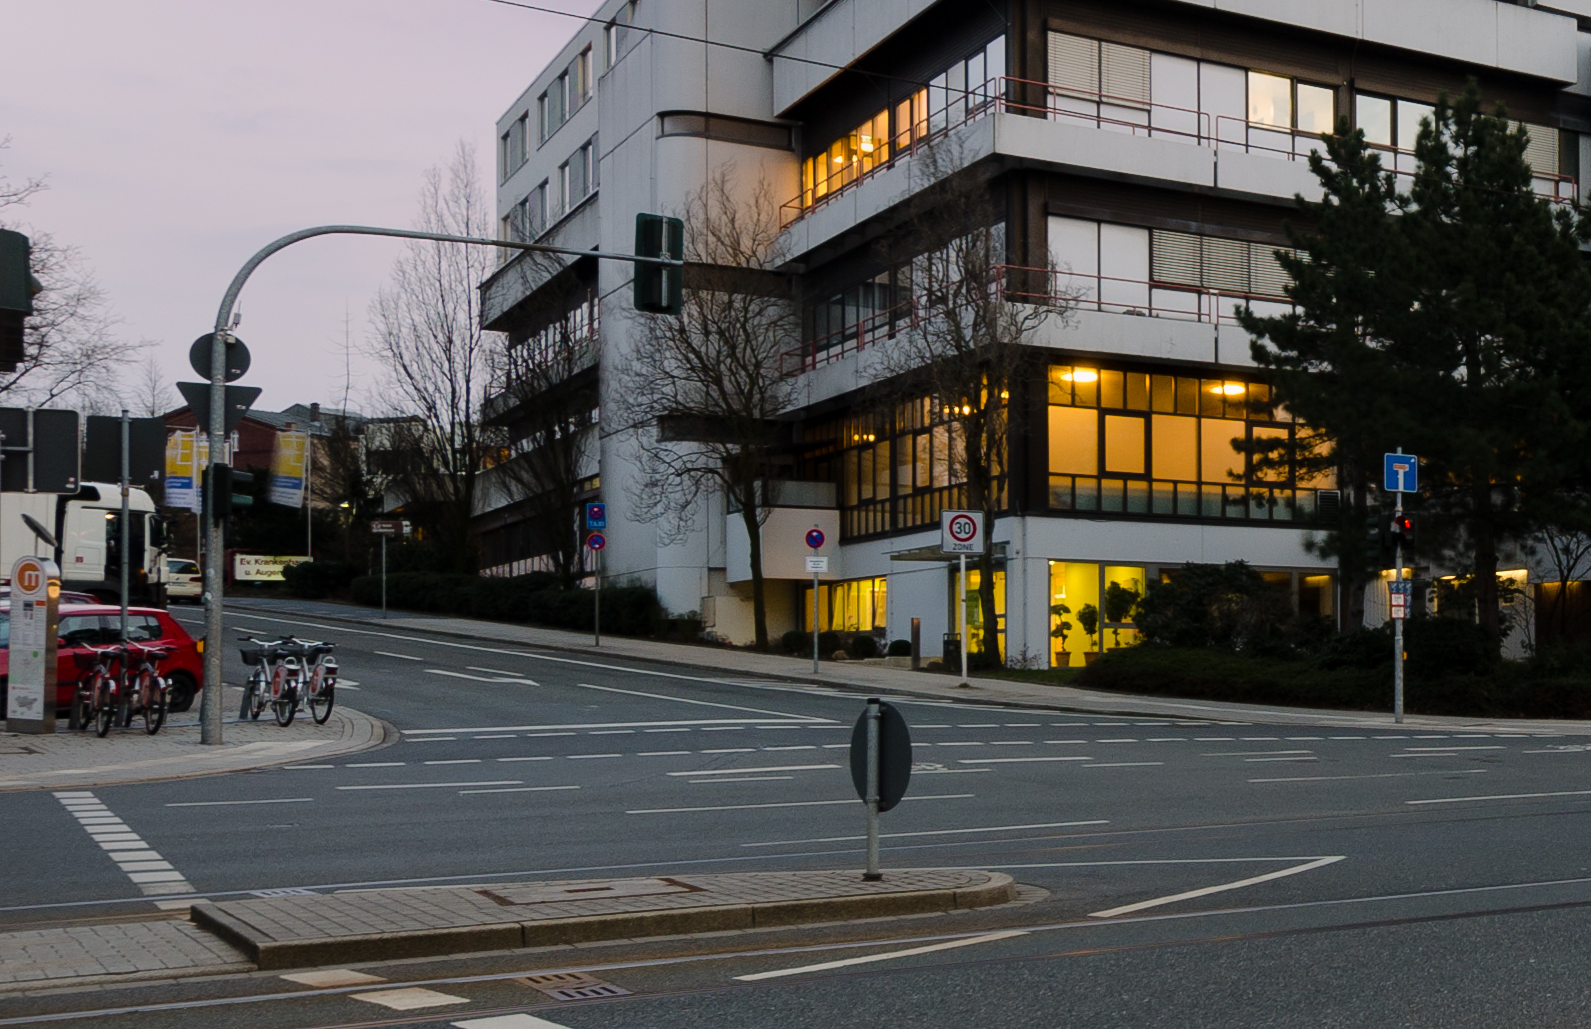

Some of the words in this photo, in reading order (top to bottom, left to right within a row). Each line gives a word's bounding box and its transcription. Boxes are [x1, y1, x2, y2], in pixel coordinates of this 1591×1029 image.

[954, 521, 972, 535] 30
[952, 542, 974, 551] ZONE
[240, 557, 252, 566] Ev.
[254, 557, 302, 566] Krankenha
[255, 568, 283, 578] Augen
